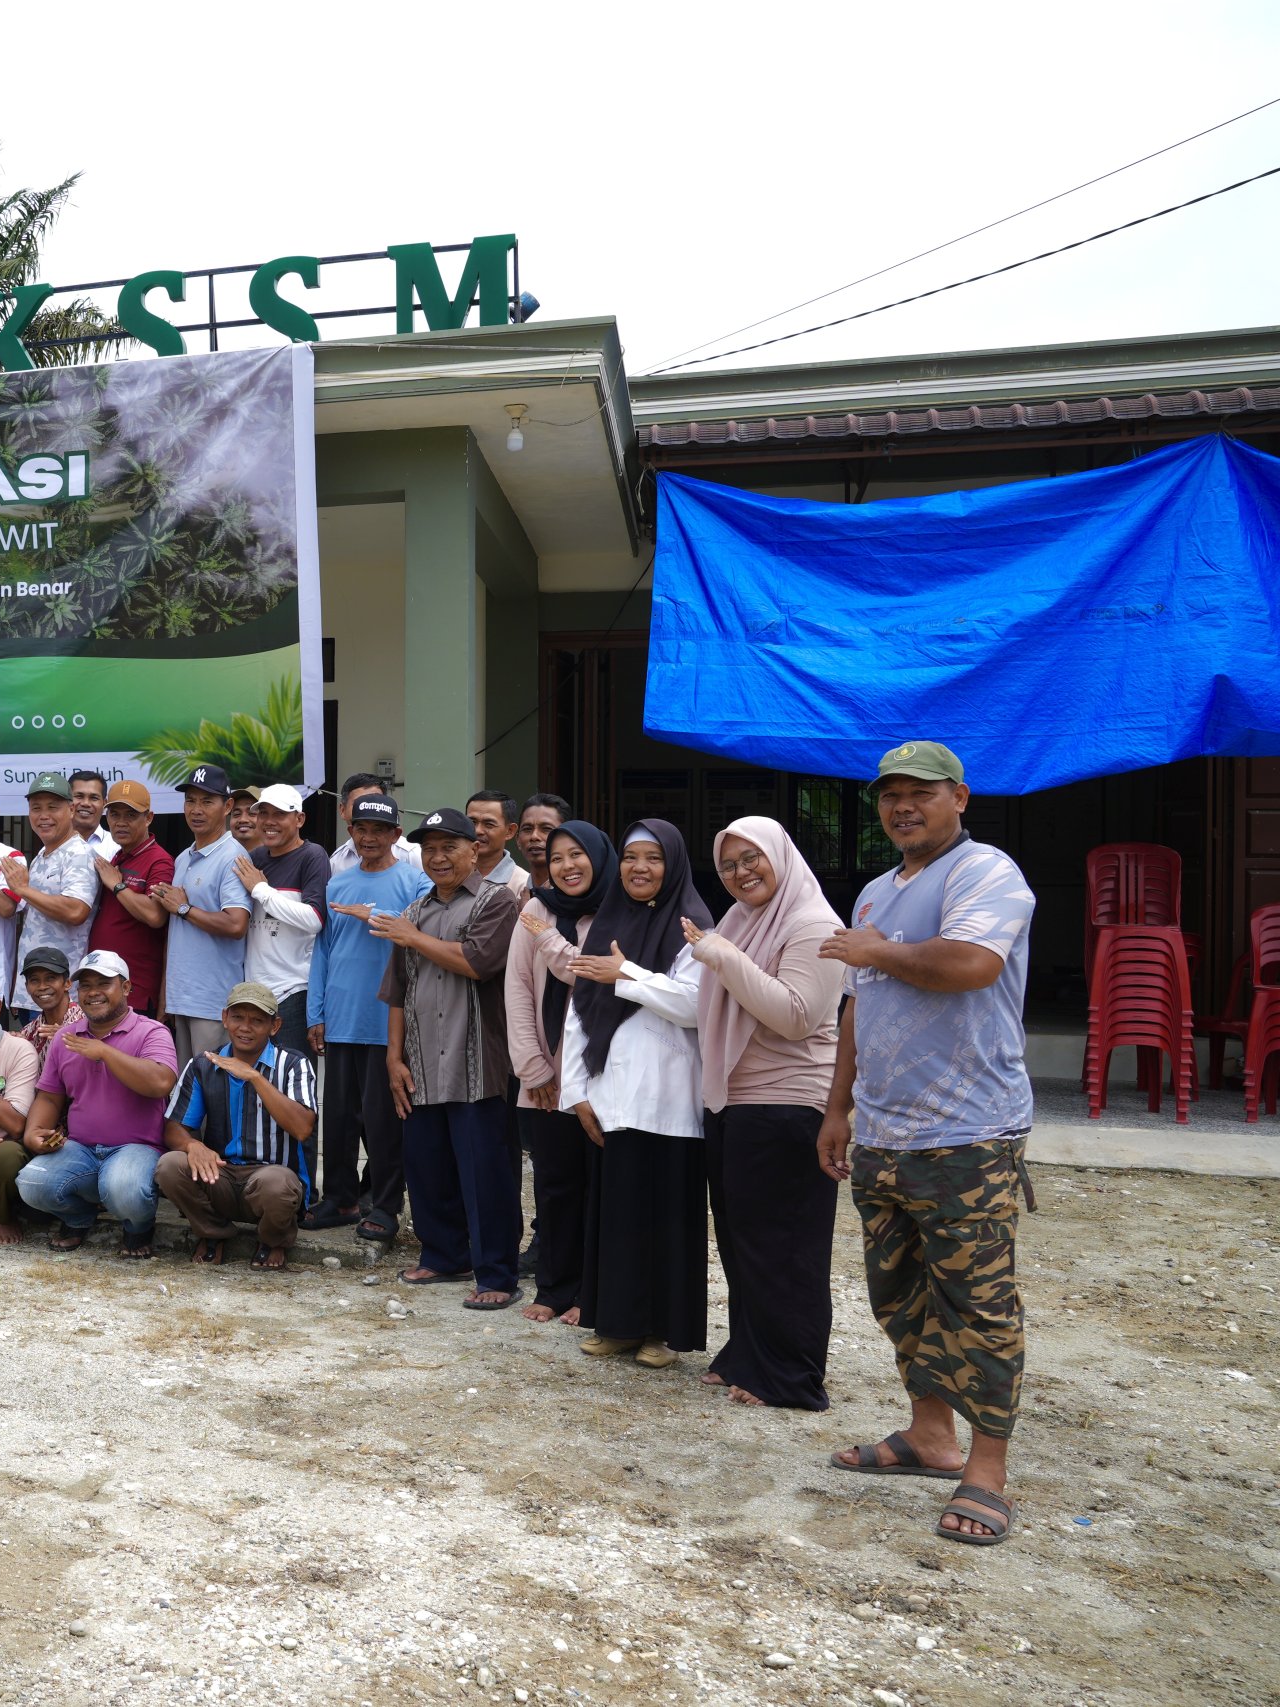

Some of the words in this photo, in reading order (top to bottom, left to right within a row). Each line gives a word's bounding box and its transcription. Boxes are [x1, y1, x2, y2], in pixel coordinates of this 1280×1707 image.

[16, 581, 72, 599] Benar
[3, 767, 67, 783] Suni
[359, 801, 393, 814] Compton
